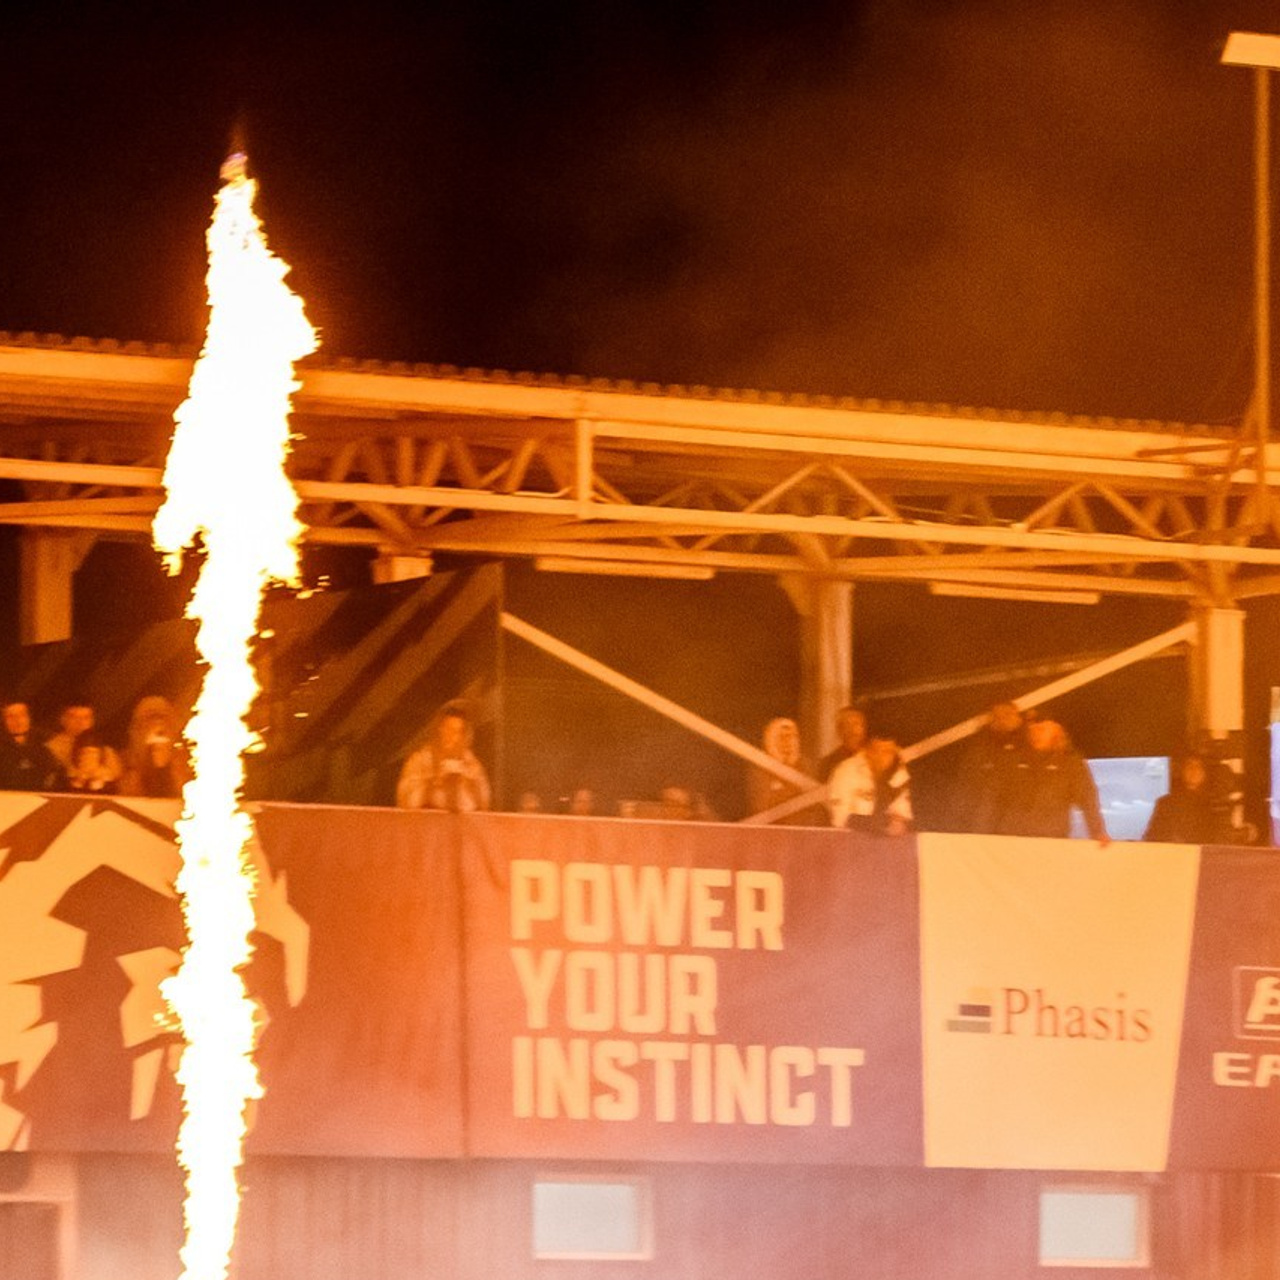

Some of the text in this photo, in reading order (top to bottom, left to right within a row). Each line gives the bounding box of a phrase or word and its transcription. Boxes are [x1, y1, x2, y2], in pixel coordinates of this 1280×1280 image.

[509, 859, 785, 951] POWER
[512, 948, 720, 1036] YOUR
[1000, 987, 1154, 1044] Phasis
[511, 1036, 867, 1128] INSTINCT
